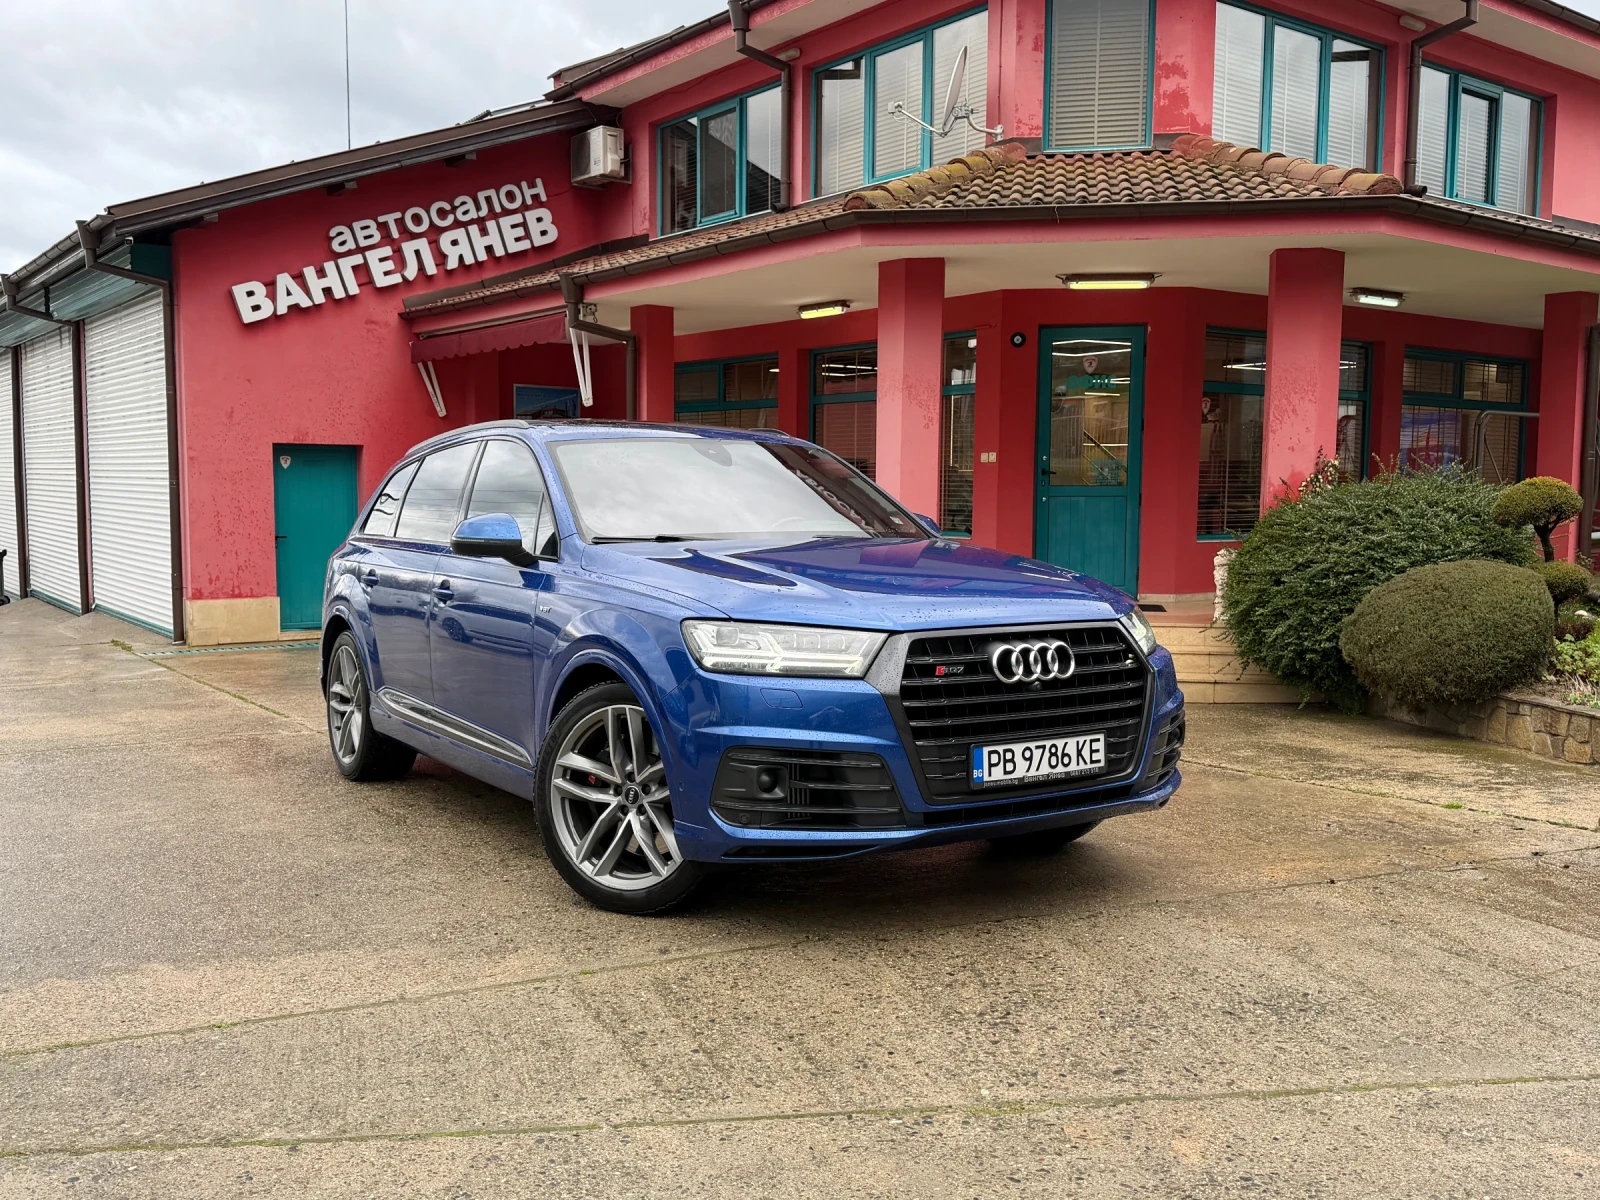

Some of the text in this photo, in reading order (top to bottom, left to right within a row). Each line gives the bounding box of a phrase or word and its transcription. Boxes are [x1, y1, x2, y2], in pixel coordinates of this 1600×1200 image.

[329, 178, 548, 253] автосалон
[231, 207, 558, 324] ВАНГЕЛ ЯНЕВ
[973, 769, 983, 778] BG
[988, 738, 1102, 777] PB 9786 KE
